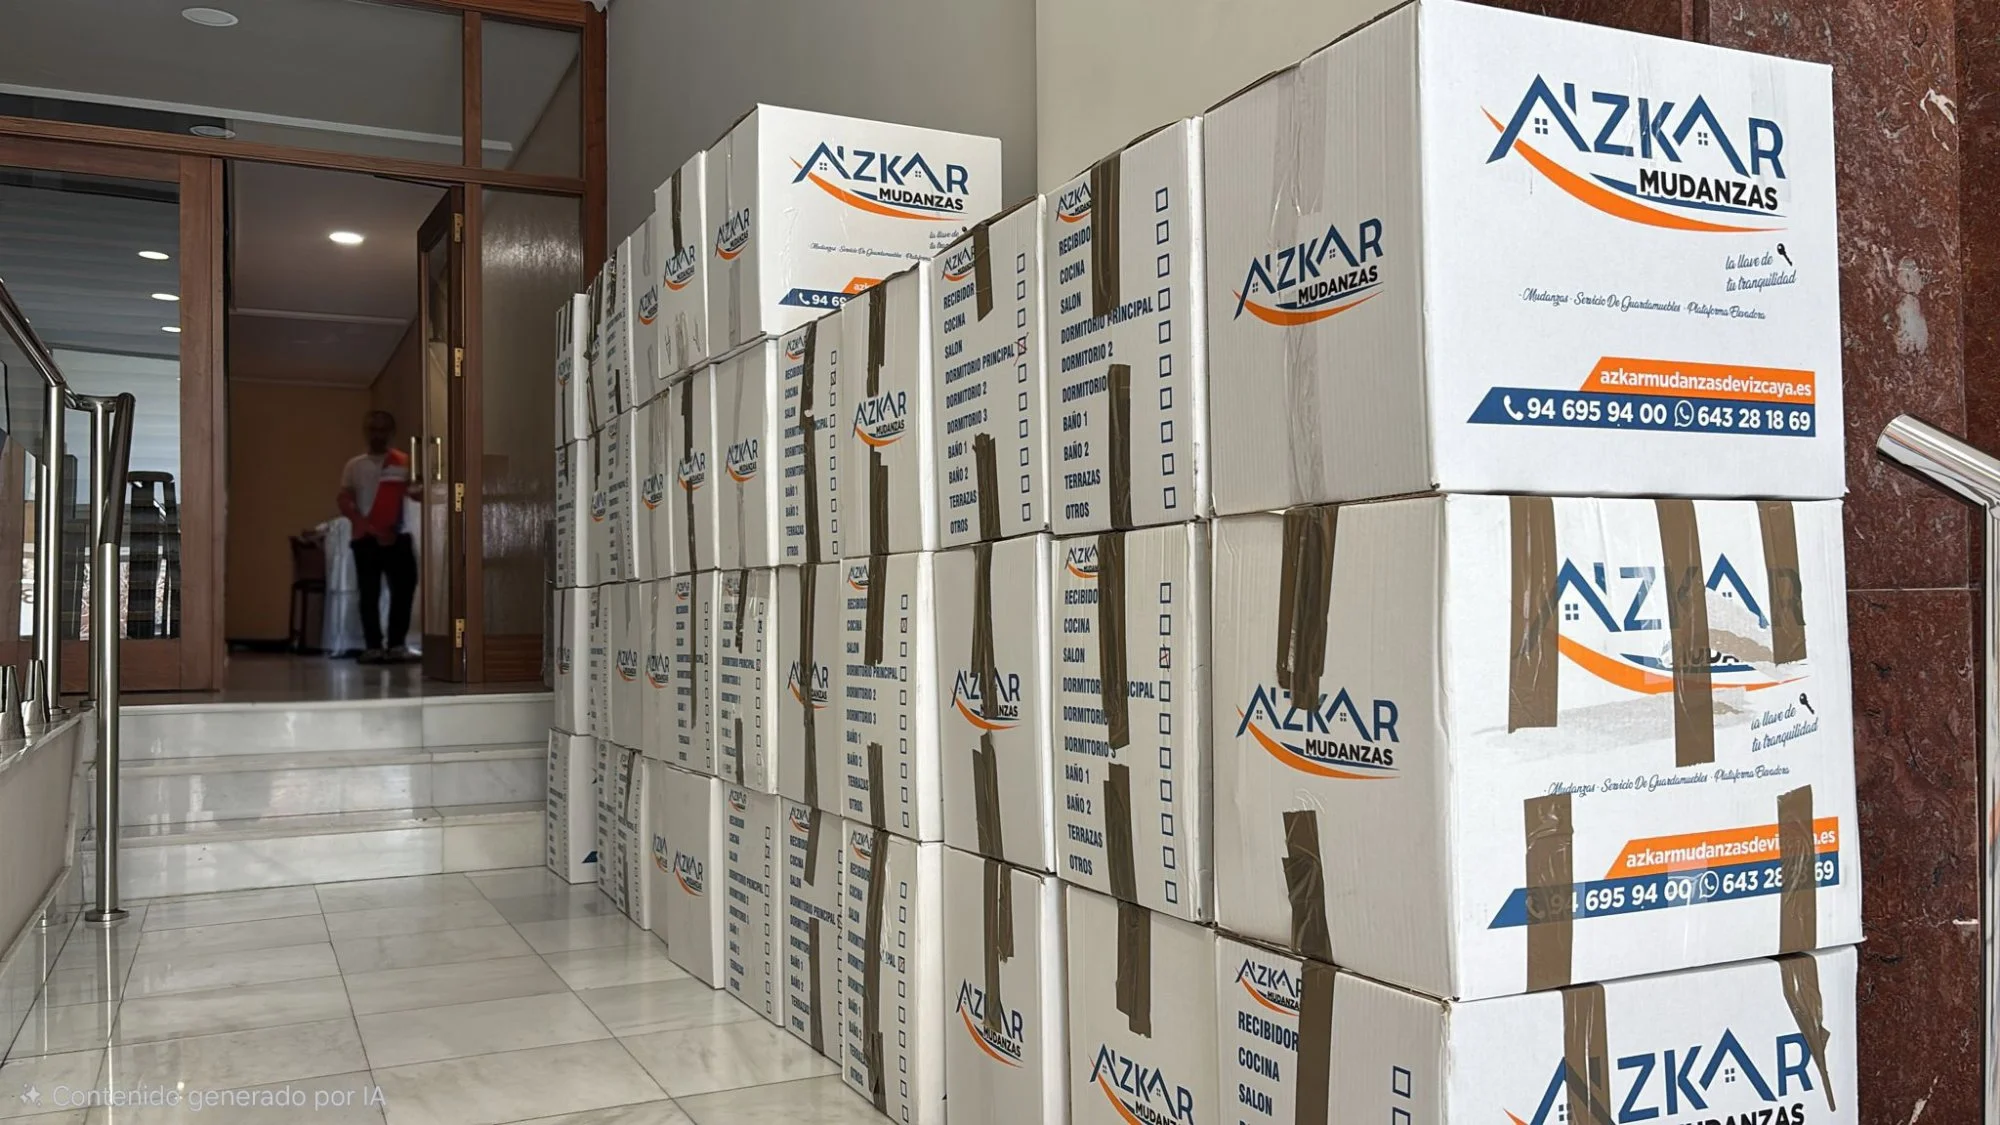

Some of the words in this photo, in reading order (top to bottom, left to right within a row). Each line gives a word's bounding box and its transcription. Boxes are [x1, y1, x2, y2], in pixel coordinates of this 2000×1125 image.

[1485, 73, 1787, 179] AZKAR
[791, 141, 969, 195] AZKAR
[879, 187, 964, 211] MUDANZAS
[1056, 181, 1092, 221] AZKA
[1639, 168, 1779, 211] MUDANZAS
[715, 207, 750, 257] AZKAR
[1059, 225, 1091, 257] RECIBIDO
[1060, 259, 1085, 285] COCINA
[1233, 217, 1384, 321] AZKAR
[1725, 255, 1736, 270] la
[1737, 253, 1760, 269] llave
[1761, 252, 1774, 267] de
[1298, 264, 1378, 305] MUDANZAS
[1726, 277, 1737, 292] tu
[1738, 270, 1797, 292] tranquilidad
[811, 294, 828, 305] 94
[944, 282, 975, 310] RECIBIDOR
[1060, 291, 1082, 314] SALON
[1522, 287, 1569, 307] Mudanzas
[1573, 291, 1606, 307] Servicio
[1606, 295, 1621, 308] De
[1621, 296, 1681, 313] Guardamuebles
[1688, 302, 1729, 319] Plataforma
[944, 312, 966, 334] COCINA
[1061, 315, 1106, 345] DORMITORIO
[1107, 296, 1153, 327] PRINCIPAL
[944, 340, 963, 359] SALON
[1062, 343, 1106, 373] DORMITORIO
[1107, 340, 1113, 357] 2
[945, 357, 981, 385] DORMITORIO
[982, 343, 1015, 369] PRINCIPAL
[946, 383, 981, 409] DORMITORIO
[982, 380, 987, 395] 2
[1062, 375, 1107, 403] DORMITORIO
[1600, 367, 1812, 398] azkarmudanzasdevizcaya.es
[852, 390, 907, 439] AZKAR
[876, 419, 905, 434] MUDANZAS
[947, 409, 982, 435] DORMITORIO
[983, 408, 988, 422] 3
[1063, 410, 1081, 432] BAÑO
[1083, 410, 1088, 426] 1
[1527, 396, 1556, 421] 94
[1561, 398, 1601, 422] 695
[1607, 401, 1634, 424] 94
[1639, 402, 1667, 425] 00
[1698, 405, 1733, 428] 643
[1738, 407, 1761, 429] 28
[1765, 409, 1784, 430] 18
[1789, 409, 1811, 431] 69
[725, 437, 758, 472] AZKAR
[947, 440, 962, 459] BAÑO
[963, 440, 968, 454] 1
[1063, 440, 1082, 461] BAÑO
[1084, 441, 1089, 457] 2
[948, 466, 964, 484] BAÑO
[964, 466, 969, 480] 2
[1064, 468, 1101, 490] TERRAZAS
[949, 489, 978, 509] TERRAZAS
[1065, 501, 1089, 520] OTROS
[950, 518, 968, 534] OTROS
[1064, 544, 1098, 570] AZKA
[1065, 588, 1098, 605] RECIBIDO
[1063, 618, 1090, 634] COCINA
[1063, 647, 1085, 663] SALON
[1235, 683, 1400, 743] AZKAR
[1762, 710, 1783, 726] llave
[1784, 703, 1797, 719] de
[1064, 736, 1109, 757] DORMITORIO
[1751, 737, 1761, 752] tu
[1762, 717, 1819, 748] tranquilidad
[1305, 738, 1394, 766] MUDANZAS
[1065, 763, 1083, 783] BAÑO
[1085, 768, 1089, 784] 1
[1600, 778, 1633, 793] Servicio
[1634, 776, 1648, 791] De
[1648, 774, 1708, 793] Guardamuebles
[1714, 769, 1754, 785] Plataforma
[1066, 793, 1085, 813] BAÑO
[1086, 799, 1091, 815] 2
[1067, 823, 1103, 848] TERRAZAS
[1069, 854, 1093, 876] OTROS
[1585, 888, 1625, 912] 695
[1631, 884, 1658, 906] 94
[1663, 879, 1693, 902] 00
[1722, 871, 1757, 894] 643
[1815, 860, 1835, 882] 69
[983, 1025, 1021, 1058] MUDANZAS
[1238, 1010, 1299, 1052] RECIBIDOR
[1238, 1046, 1280, 1082] COCINA
[1089, 1043, 1194, 1125] AZKAR
[1239, 1083, 1272, 1117] SALON
